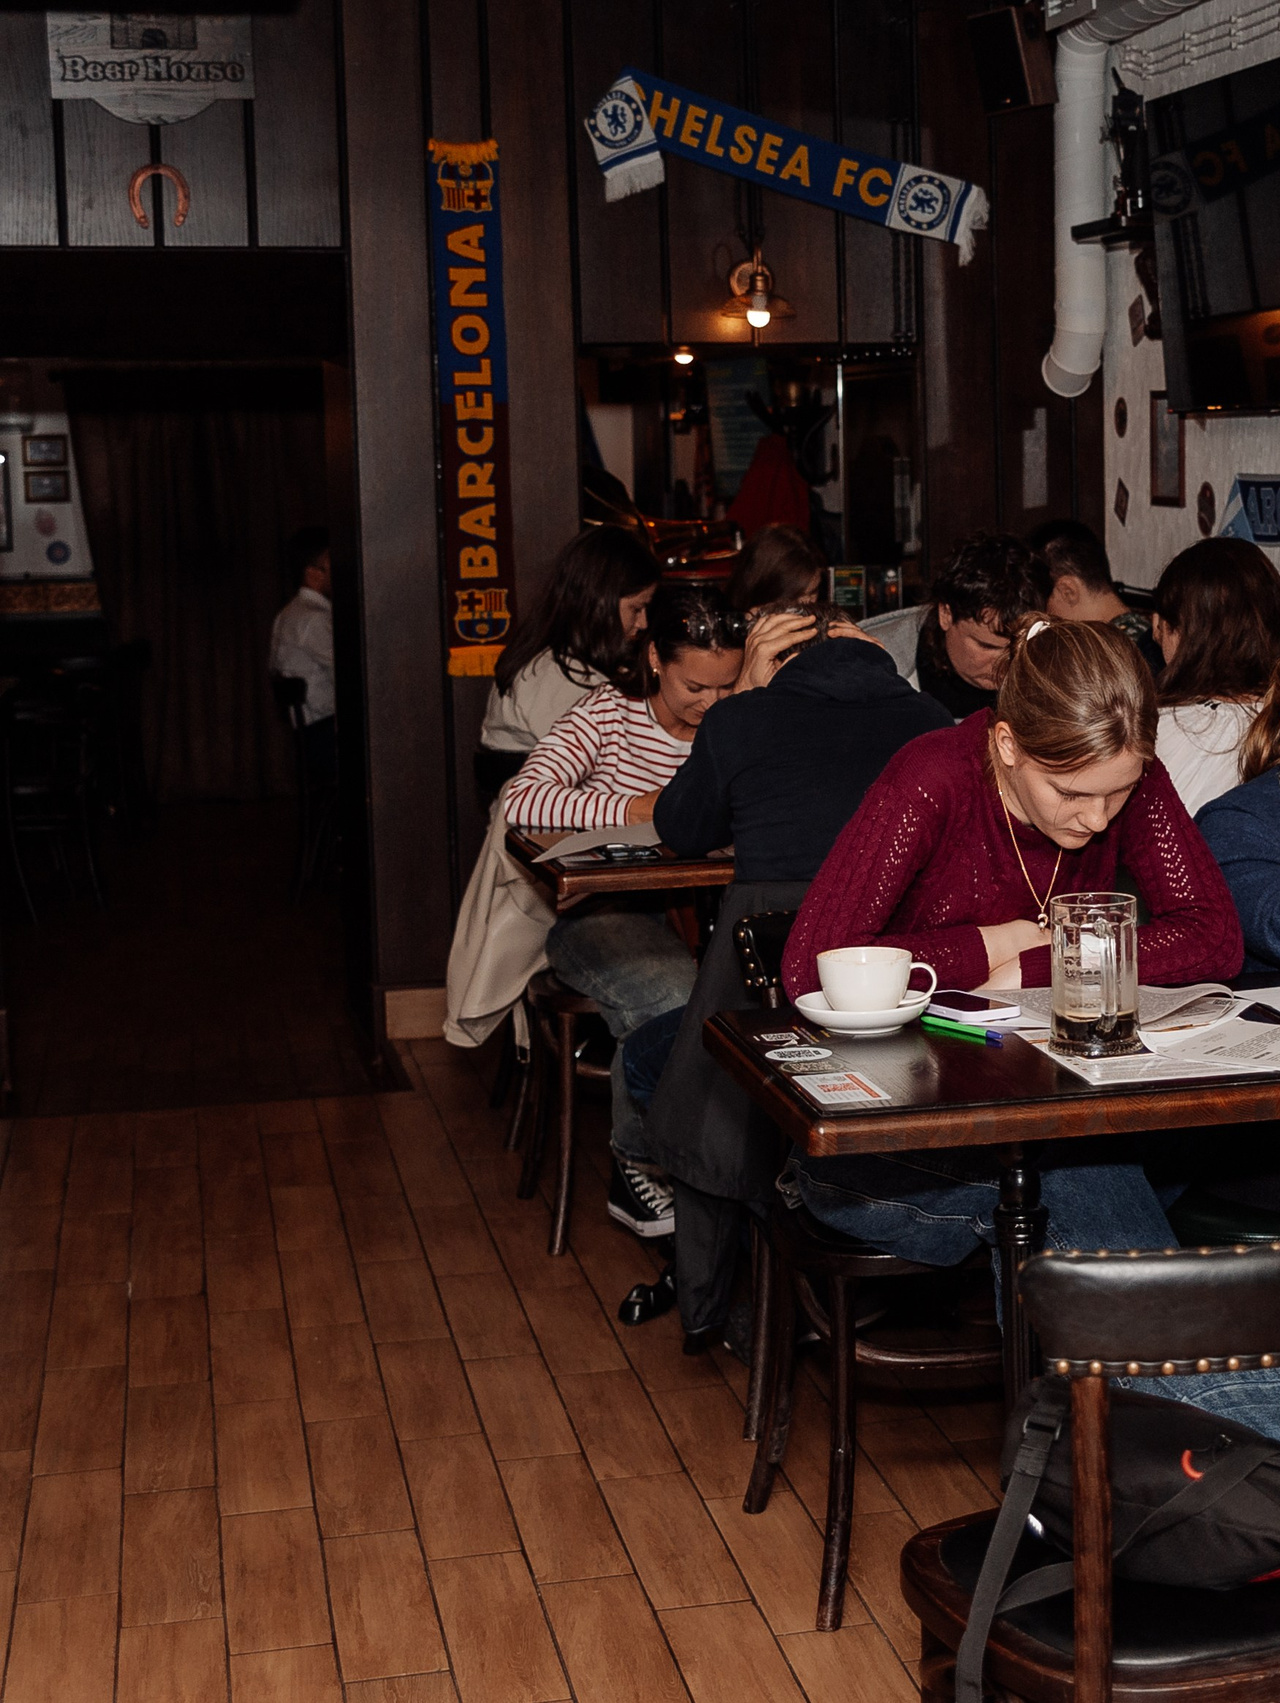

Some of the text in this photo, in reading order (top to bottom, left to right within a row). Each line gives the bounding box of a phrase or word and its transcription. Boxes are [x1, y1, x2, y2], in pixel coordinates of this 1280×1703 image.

[59, 55, 246, 83] Beer House
[832, 158, 893, 207] FC
[446, 223, 499, 580] BARCELONA
